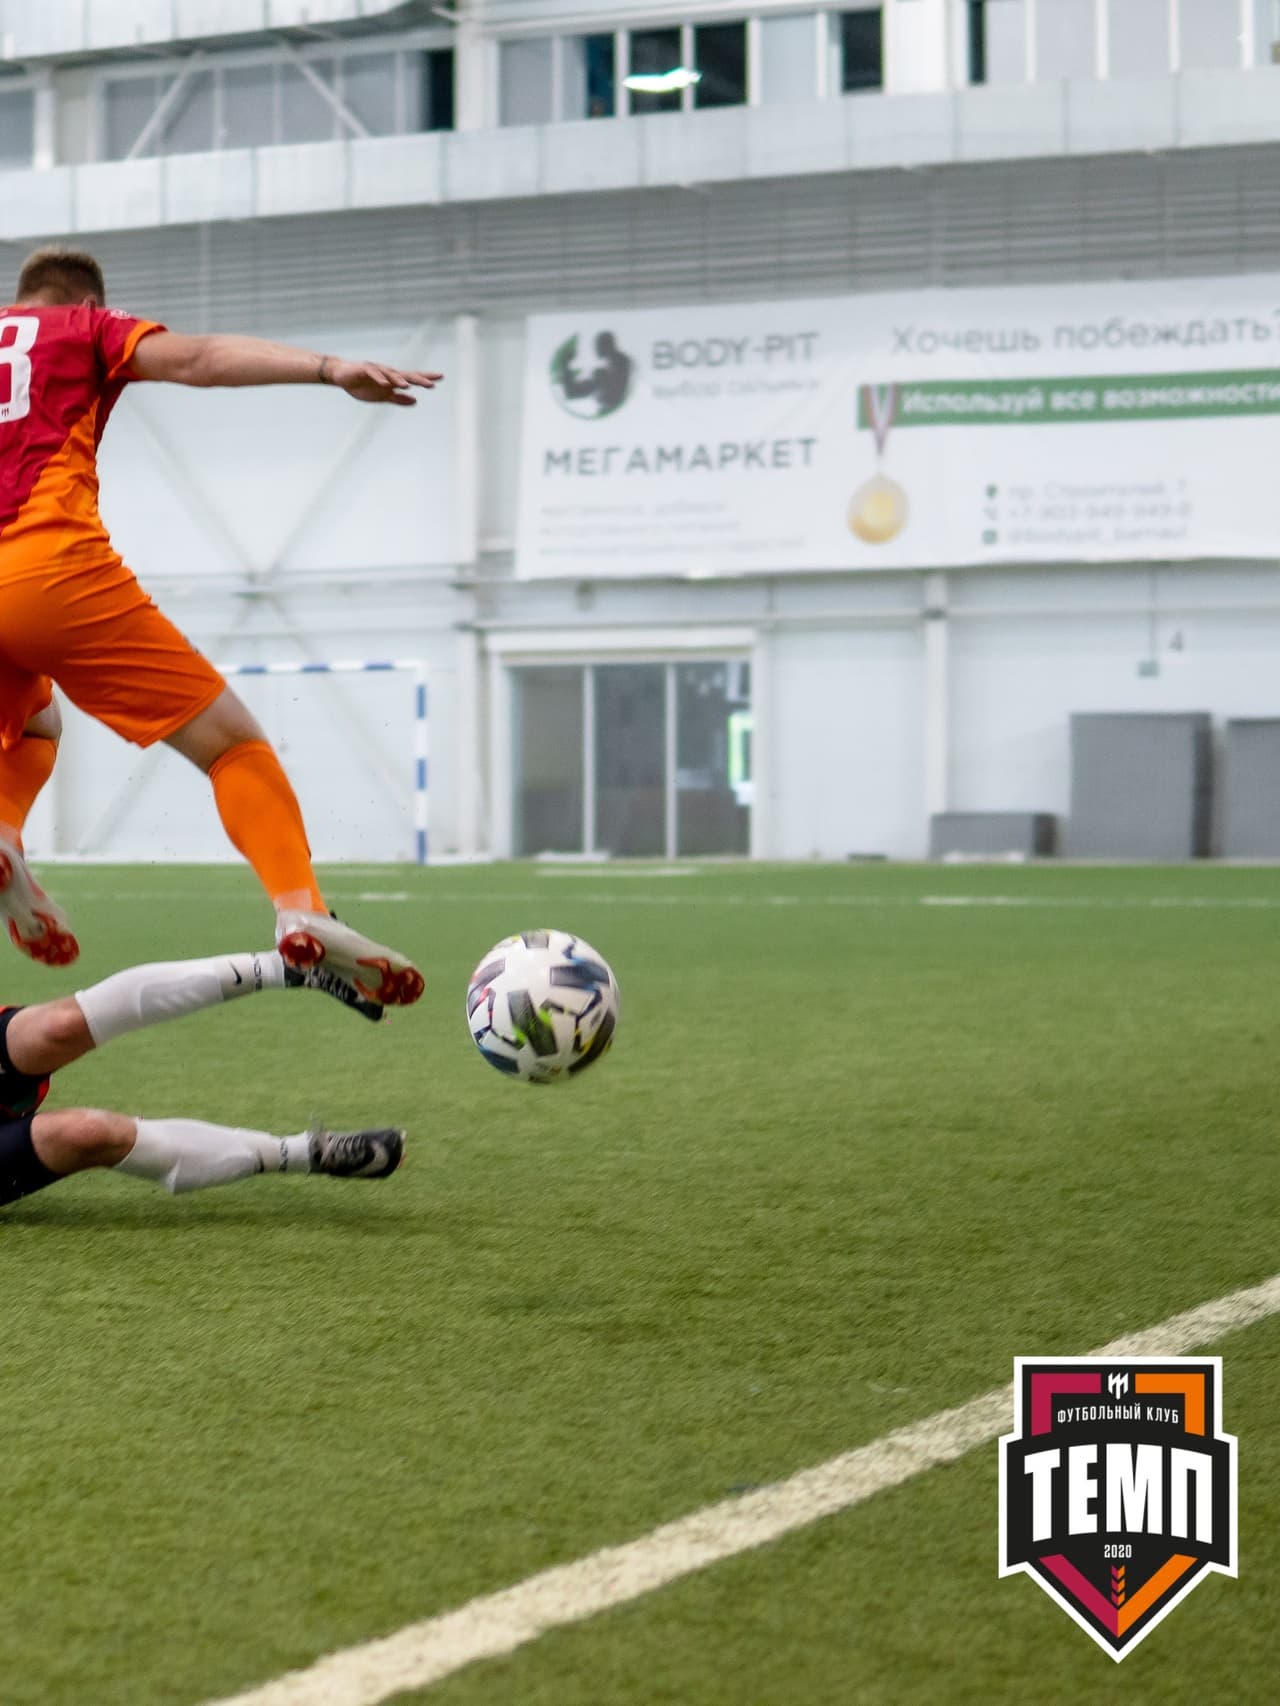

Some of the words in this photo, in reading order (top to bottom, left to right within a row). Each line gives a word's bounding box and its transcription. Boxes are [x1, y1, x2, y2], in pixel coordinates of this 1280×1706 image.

[652, 332, 819, 370] BODY-PIT
[891, 325, 1041, 355] Хочешь
[903, 386, 1044, 416] Используй
[1051, 389, 1096, 411] все
[542, 438, 818, 477] МЕГАМАРКЕТ
